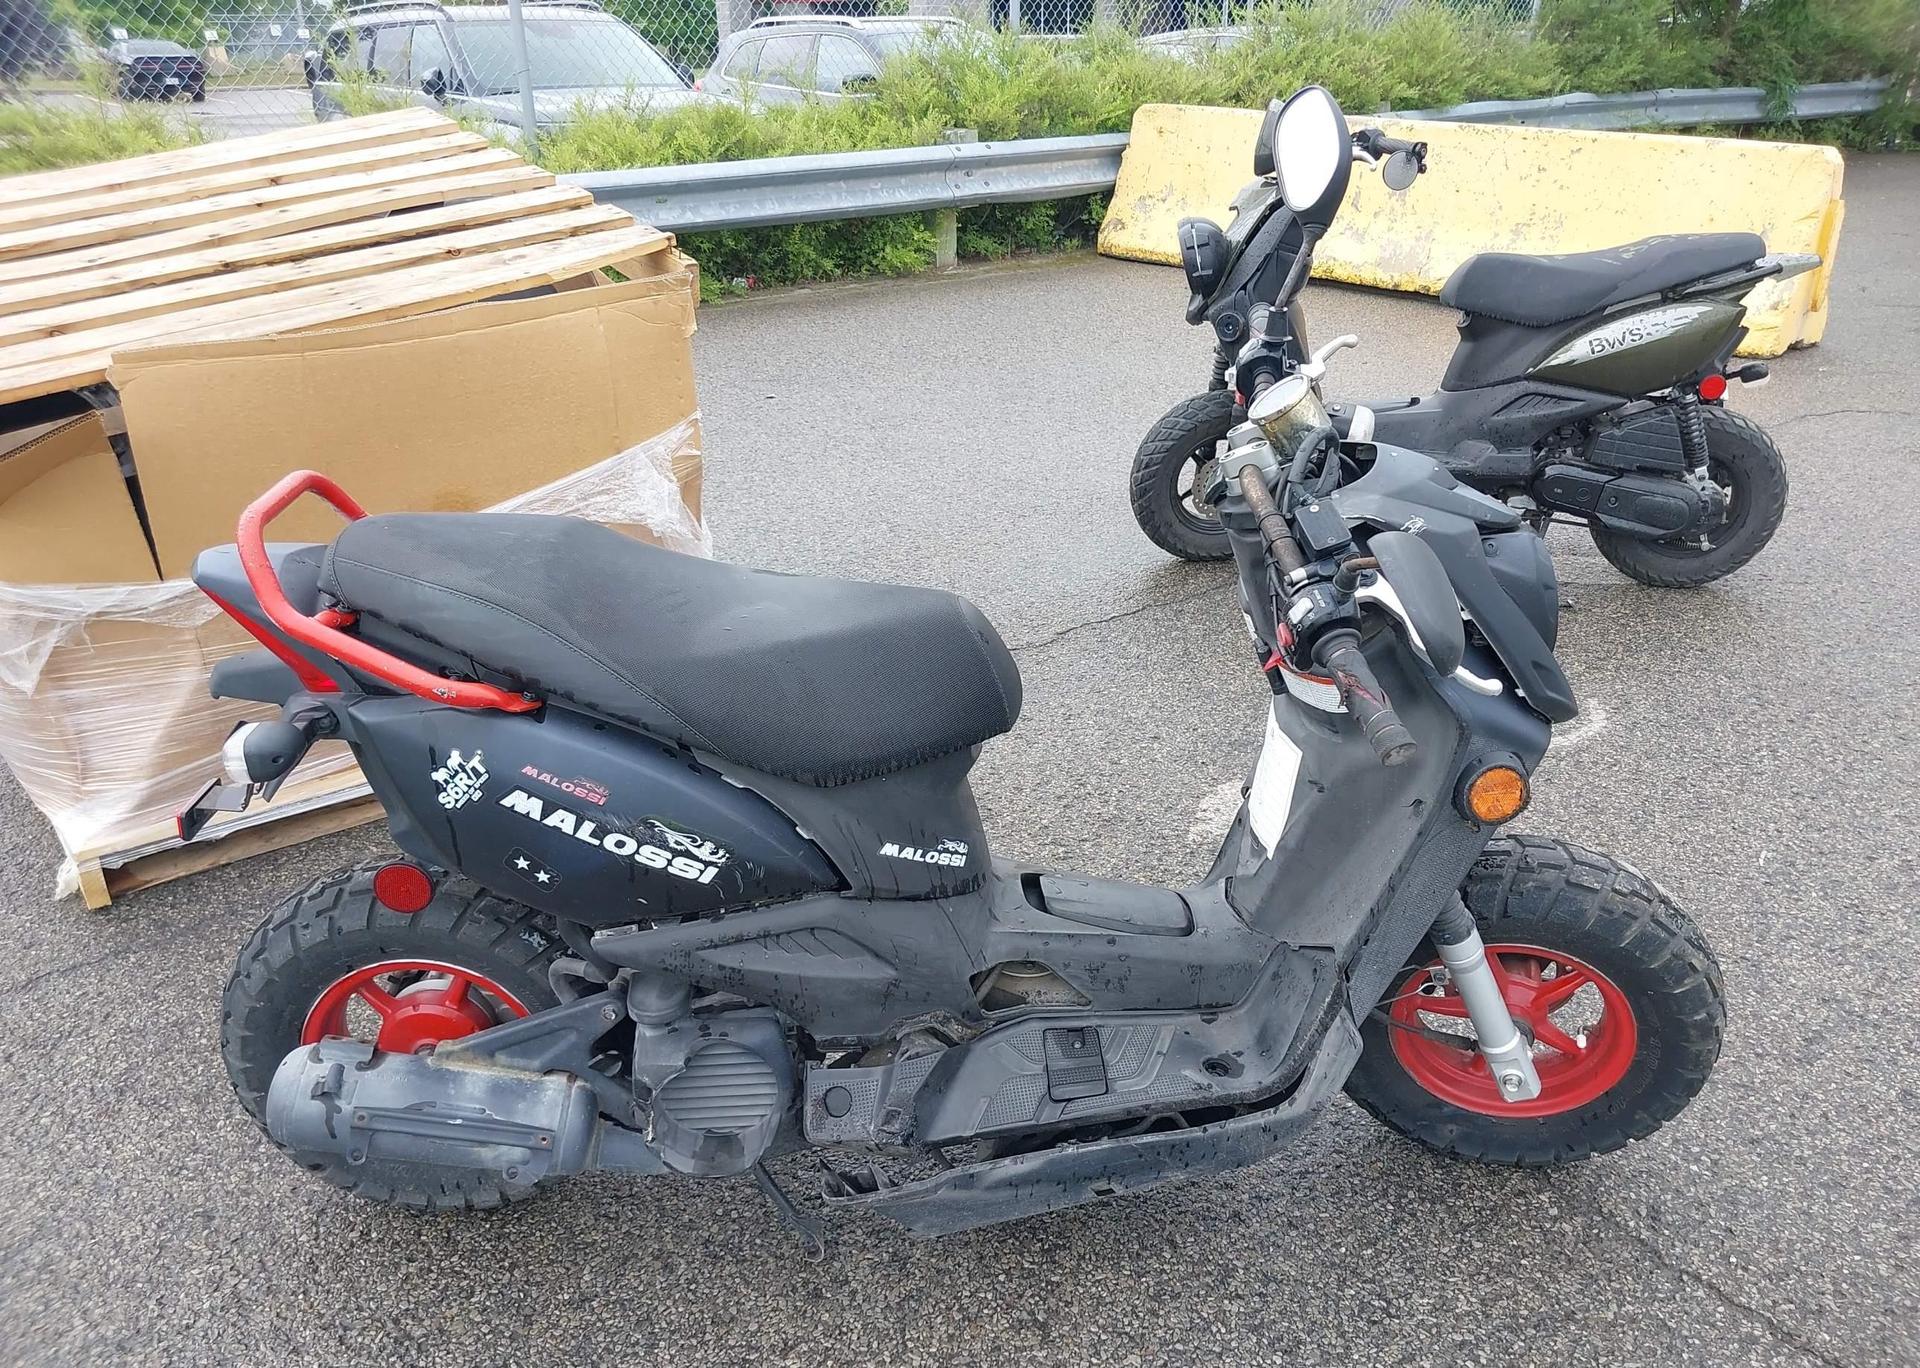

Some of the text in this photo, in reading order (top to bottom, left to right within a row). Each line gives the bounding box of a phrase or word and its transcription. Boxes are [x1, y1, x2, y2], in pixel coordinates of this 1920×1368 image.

[521, 765, 607, 806] MALOSSI
[499, 789, 720, 884] MALOSSI
[880, 842, 967, 867] MALOSSI
